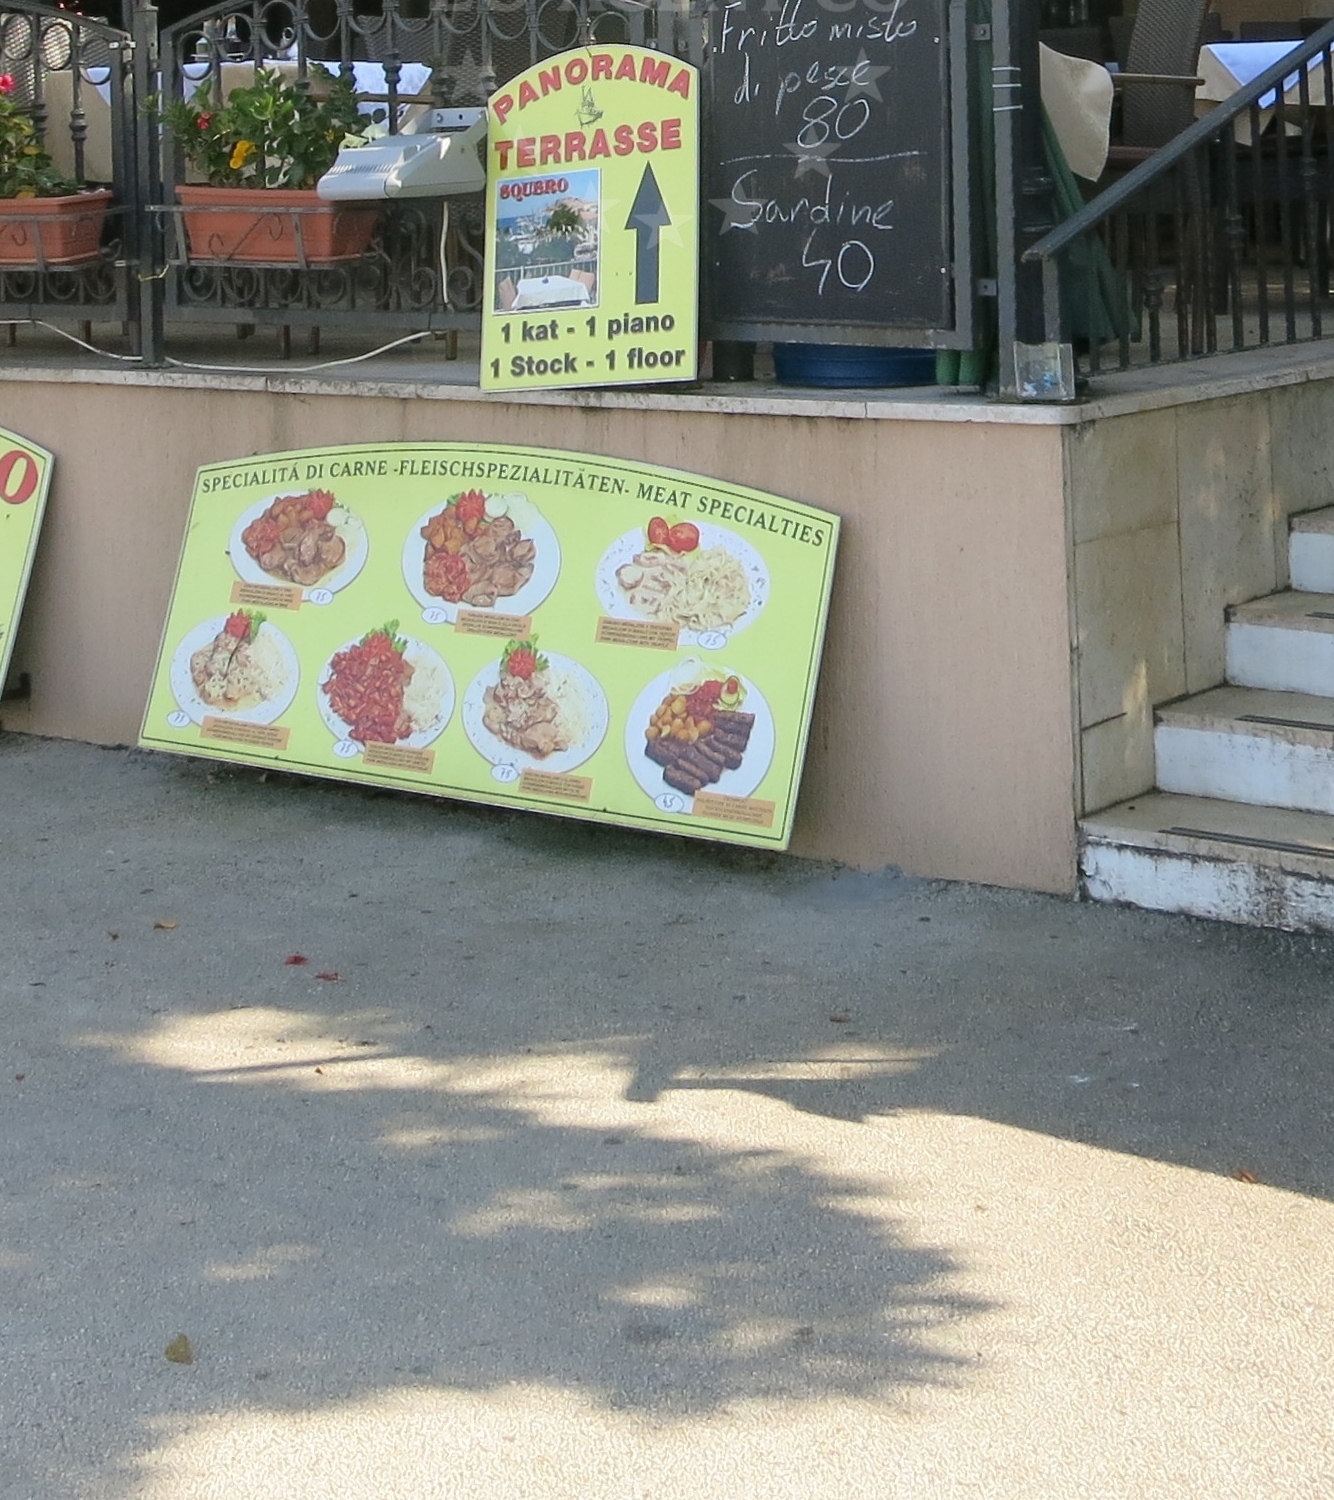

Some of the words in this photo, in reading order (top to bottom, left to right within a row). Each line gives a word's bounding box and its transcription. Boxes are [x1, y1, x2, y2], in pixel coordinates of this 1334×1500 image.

[492, 53, 691, 124] PANORAMA
[776, 59, 872, 115] pesce
[495, 118, 683, 169] TERRASSE
[797, 95, 870, 148] 80
[731, 168, 895, 232] Sardine
[500, 324, 511, 343] 1
[521, 317, 559, 342] kat
[586, 316, 597, 337] 1
[607, 311, 675, 337] piano
[490, 358, 500, 379] 1
[510, 352, 577, 377] Stock
[605, 351, 616, 371] 1
[627, 345, 686, 370] floor
[306, 463, 324, 479] DI
[330, 459, 388, 478] CARNE
[636, 482, 692, 509] MEAT
[697, 496, 824, 547] SPECIALTIES
